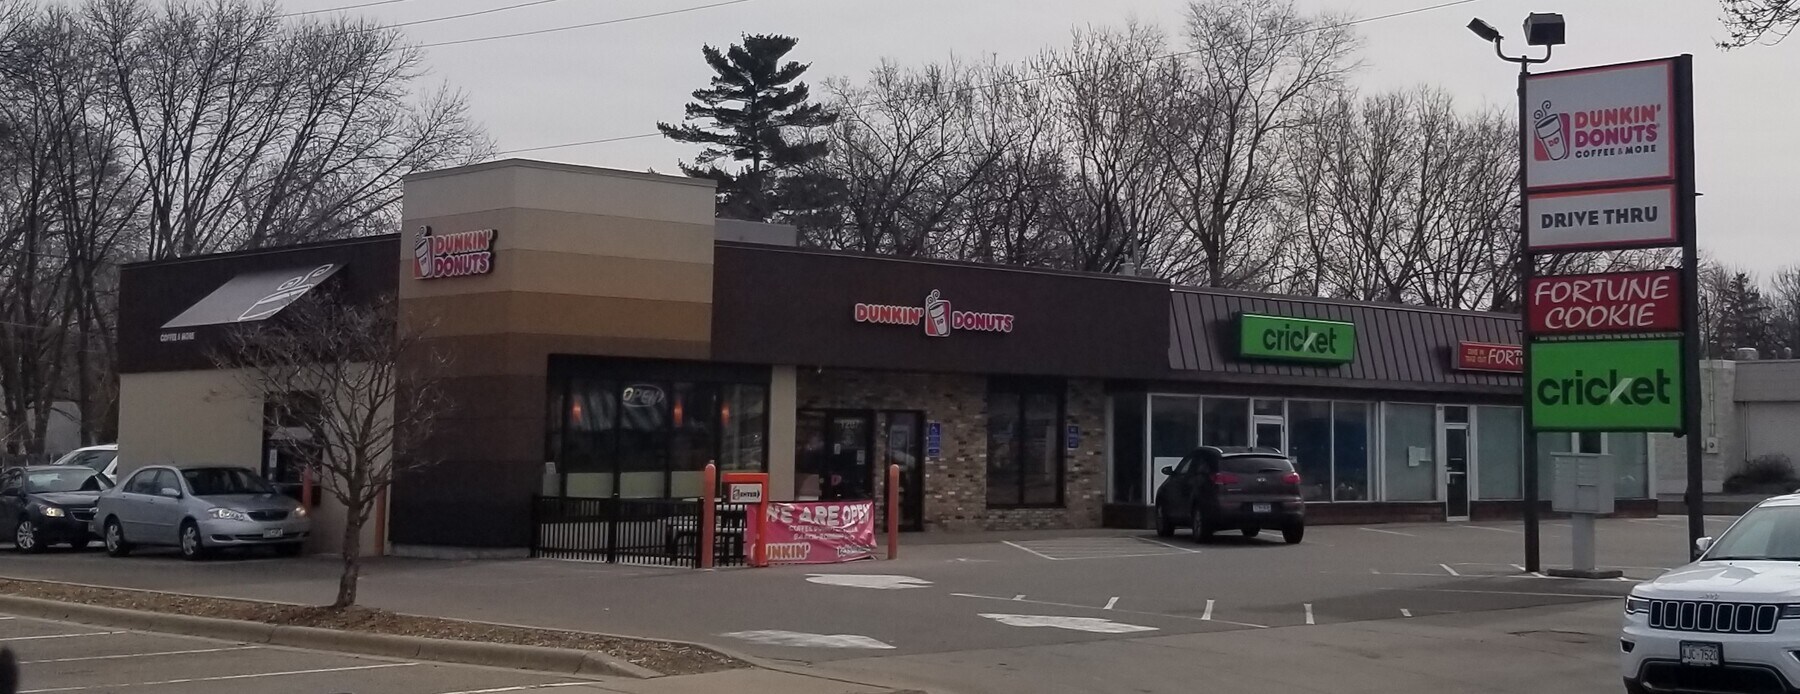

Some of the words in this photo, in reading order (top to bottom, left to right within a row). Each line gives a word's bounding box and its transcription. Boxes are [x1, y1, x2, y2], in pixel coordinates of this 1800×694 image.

[1575, 104, 1661, 128] DUNKIN'
[1575, 124, 1658, 148] DONUTS
[1575, 147, 1615, 159] COFFEE
[1625, 144, 1656, 155] MORE
[1541, 210, 1599, 229] DRIVE
[1603, 206, 1658, 225] THRU
[434, 229, 493, 256] DUNKIN'
[434, 251, 491, 278] DONUTS
[1535, 276, 1670, 305] FORTUNE
[855, 303, 924, 326] DUNKIN'
[952, 311, 1014, 333] DONUTS
[1545, 302, 1656, 329] COOKIE
[1262, 323, 1337, 354] cricket
[1536, 367, 1671, 406] cricket
[798, 505, 840, 526] ARE
[842, 503, 871, 526] OPEN
